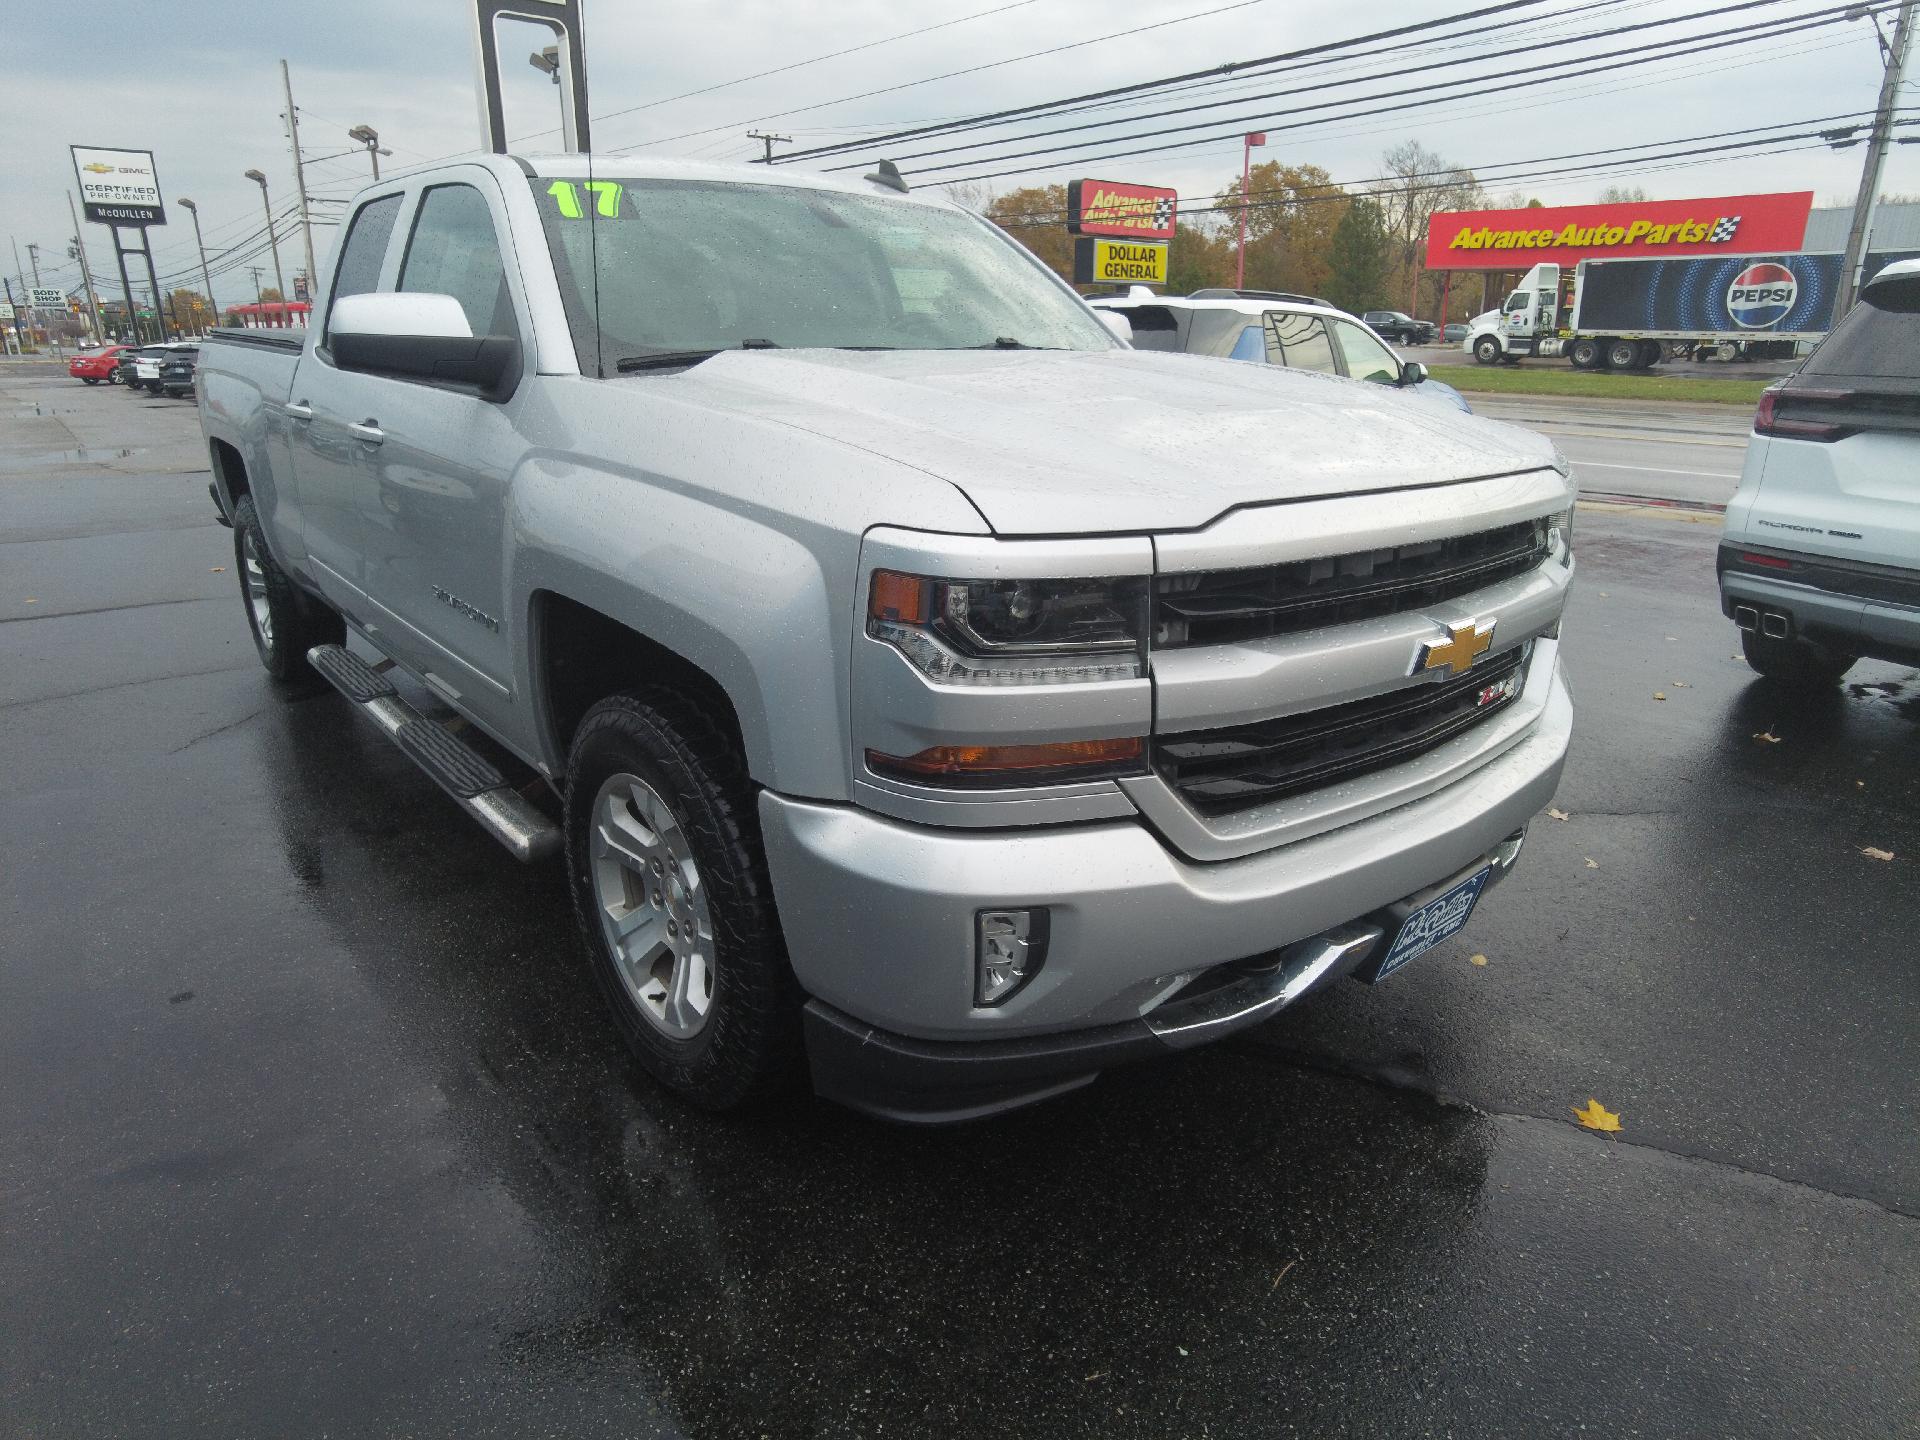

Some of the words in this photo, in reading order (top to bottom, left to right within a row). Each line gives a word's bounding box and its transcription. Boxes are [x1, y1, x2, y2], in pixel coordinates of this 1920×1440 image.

[118, 167, 151, 175] GMC
[84, 184, 156, 195] CERTIFIED
[90, 191, 154, 202] PRE-OWNED
[546, 180, 623, 219] 17
[1089, 189, 1153, 214] Advance
[97, 208, 153, 219] McQUILLEN
[1449, 227, 1554, 249] Advance
[1552, 223, 1626, 247] Auto
[1623, 219, 1707, 245] Parts
[1108, 245, 1156, 263] DOLLAR
[1104, 262, 1159, 280] GENERAL
[1731, 287, 1793, 303] PEPSI
